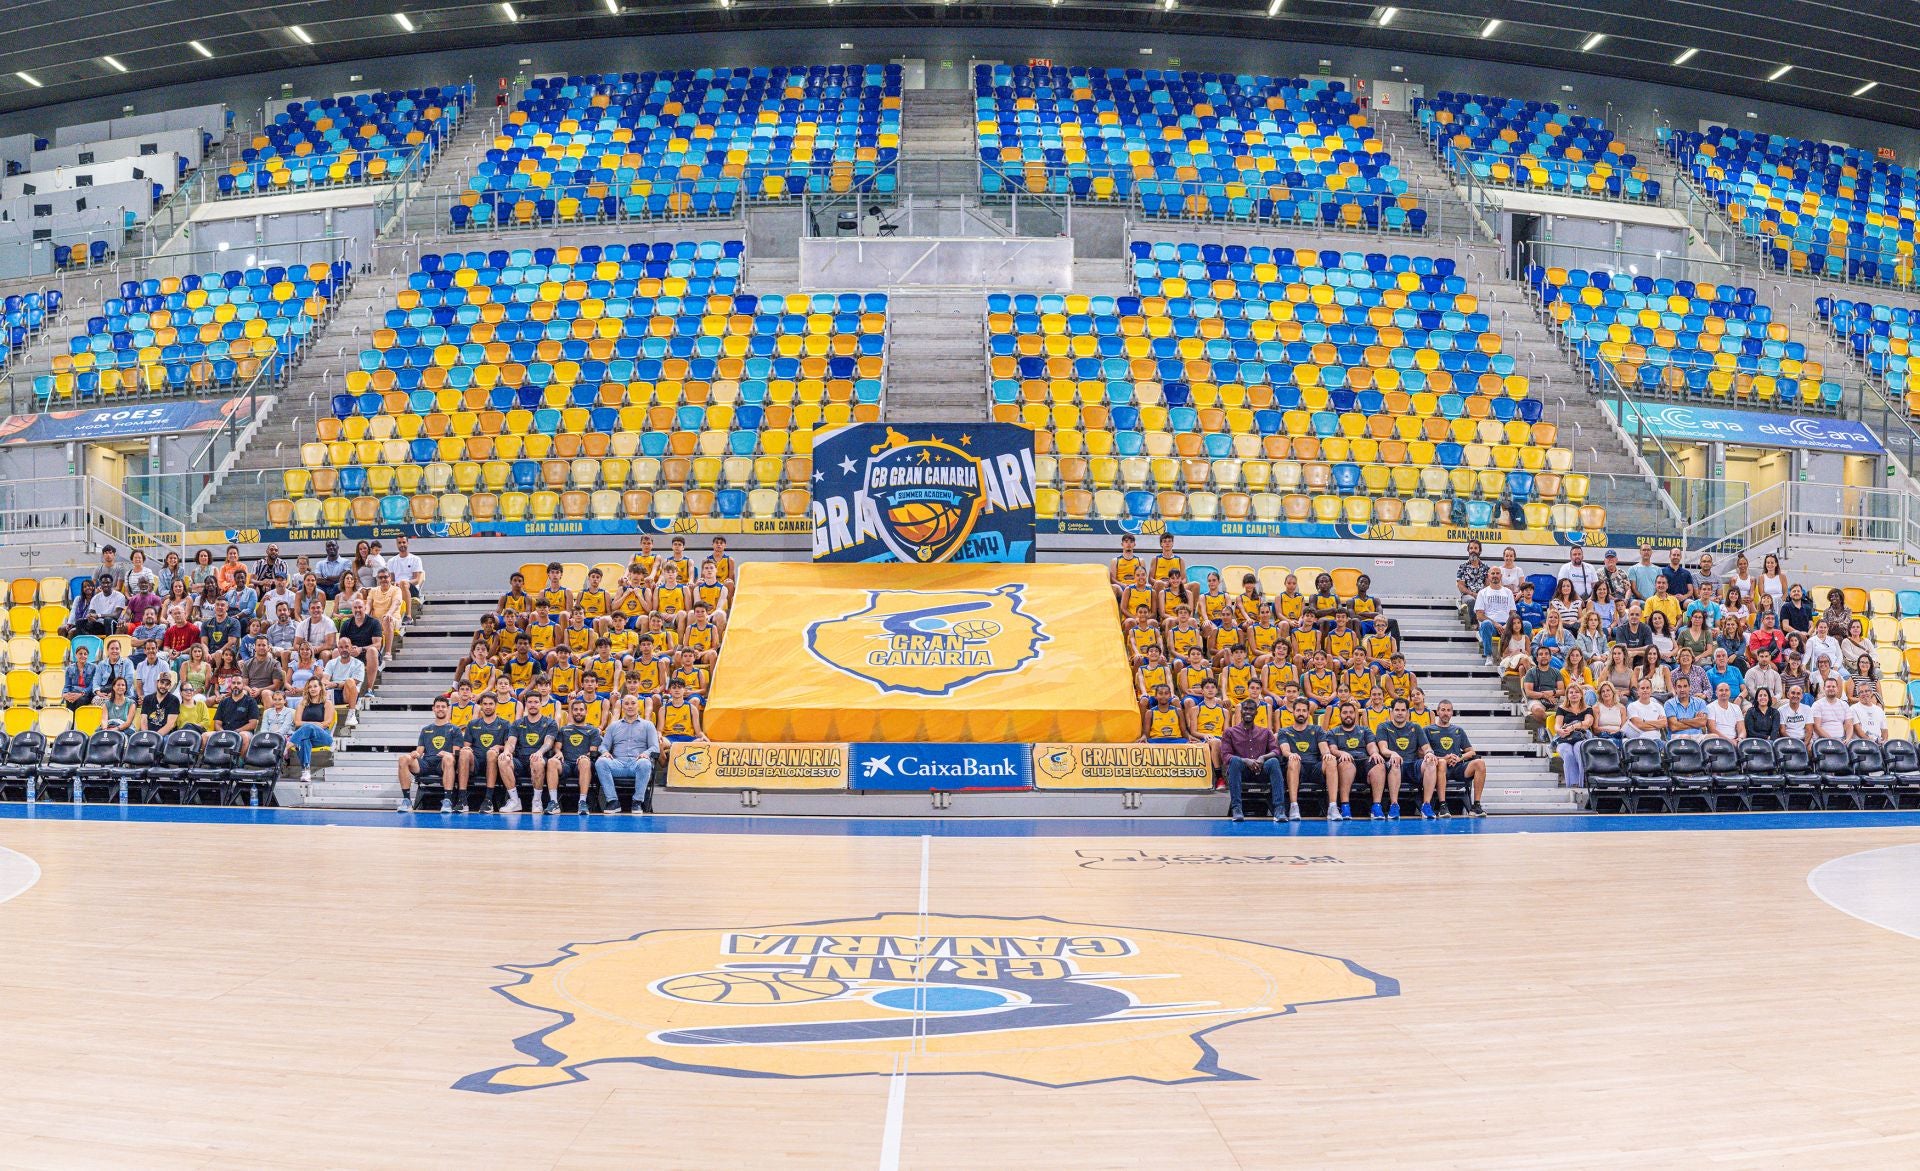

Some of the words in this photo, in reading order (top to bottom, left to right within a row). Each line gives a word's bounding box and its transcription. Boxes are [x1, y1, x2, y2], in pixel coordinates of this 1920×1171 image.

[94, 409, 164, 422] ROES
[115, 418, 169, 428] HOMBRE
[872, 467, 888, 488] CB
[890, 466, 923, 486] GRAN
[925, 466, 978, 488] CANARIA
[898, 491, 922, 499] SUMMER
[924, 490, 952, 499] ACADEMY
[525, 523, 546, 534] GRAN
[549, 522, 583, 533] CANARIA
[754, 519, 775, 532] GRAN
[779, 518, 813, 532] CANARIA
[1222, 523, 1243, 534] GRAN
[1246, 524, 1280, 535] CANARIA
[289, 529, 308, 540] GRAN
[311, 528, 340, 539] CANARI
[1447, 529, 1467, 540] GRAN
[1470, 530, 1502, 541] CANARIA
[1636, 536, 1656, 547] GRAN
[1658, 537, 1682, 548] CANAR
[892, 634, 965, 650] GRAN
[869, 651, 993, 666] CANARIA
[717, 747, 763, 767] GRAN
[766, 748, 840, 767] CANARIA
[1081, 748, 1128, 767] GRAN
[1131, 748, 1206, 767] CANARIA
[716, 767, 746, 777] CLUB
[749, 767, 763, 777] DE
[765, 767, 840, 777] BALONCESTO
[898, 757, 1018, 777] CaixaBank
[1082, 768, 1112, 777] CLUB
[1115, 768, 1130, 777] DE
[1132, 768, 1207, 777] BALONCESTO
[730, 935, 1132, 957] CANARIA
[804, 956, 1074, 980] GRAN
